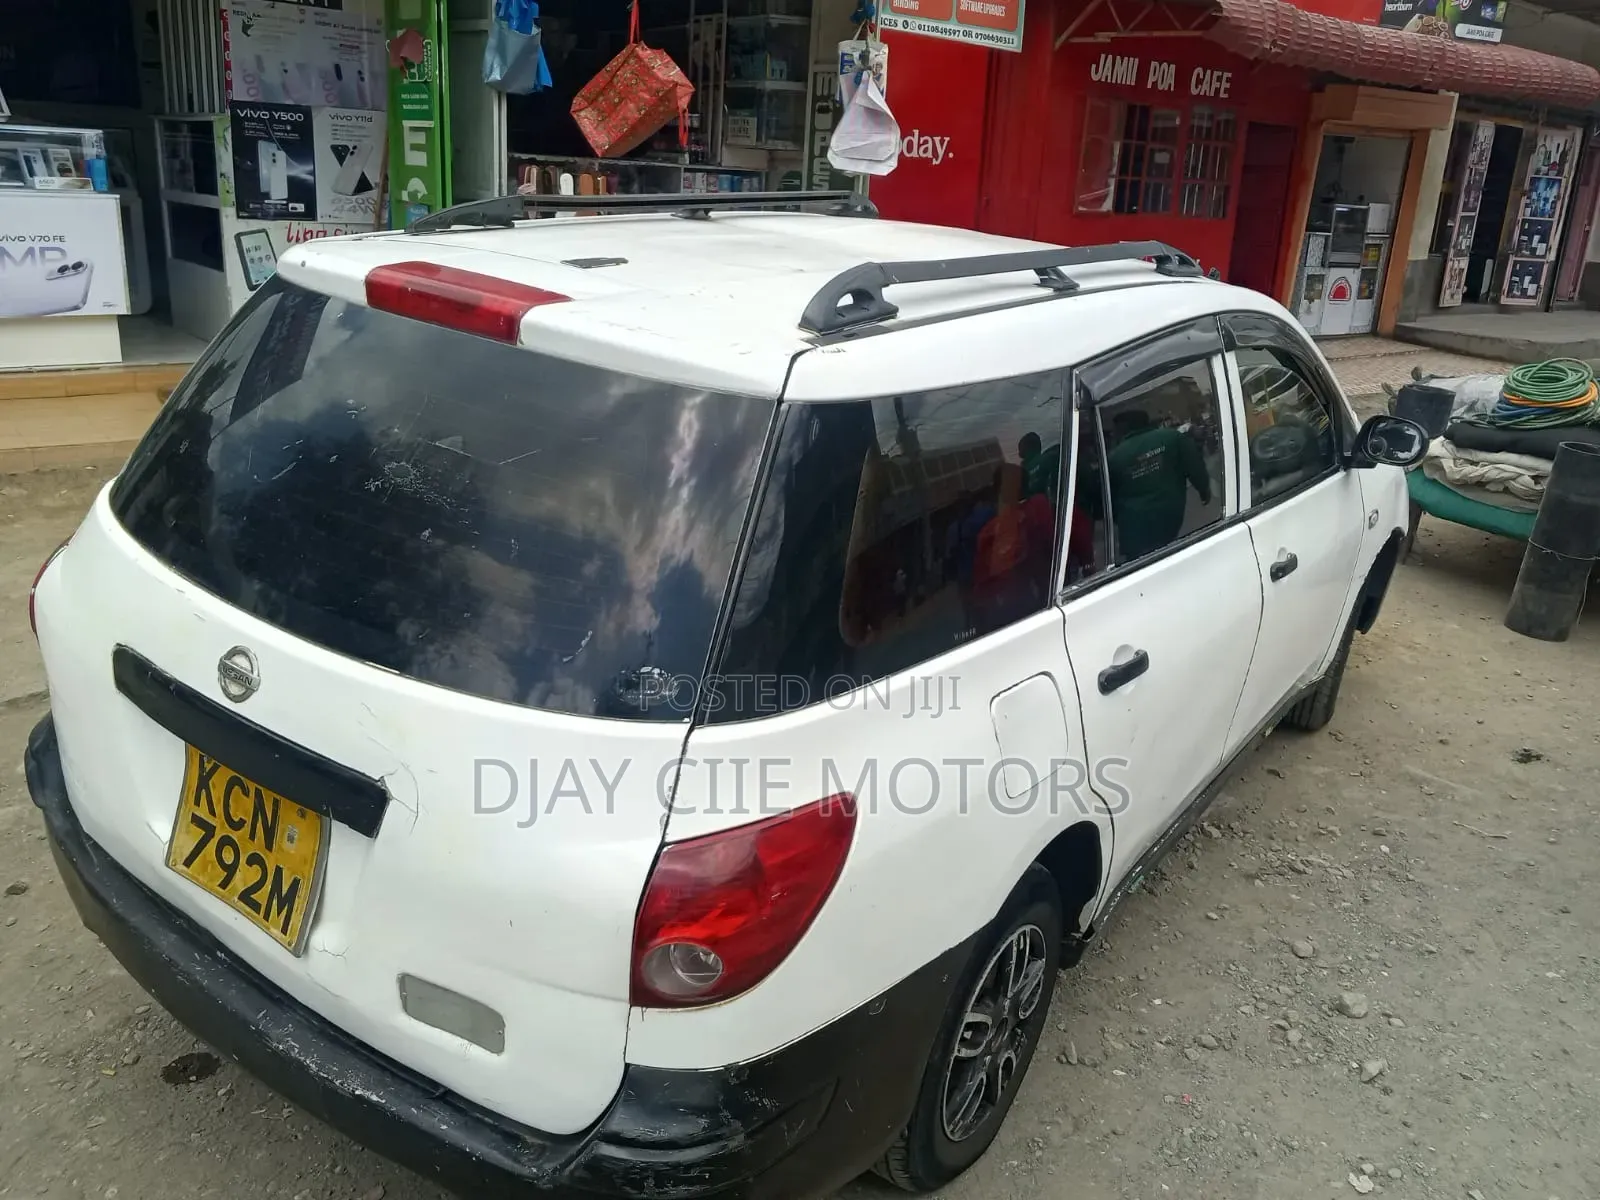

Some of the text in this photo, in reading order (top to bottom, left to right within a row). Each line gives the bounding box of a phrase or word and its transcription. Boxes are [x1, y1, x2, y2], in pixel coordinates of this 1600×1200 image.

[962, 29, 973, 39] OR
[1090, 53, 1232, 98] JAMII POA CAFE
[236, 108, 304, 122] vivo Y500
[329, 112, 353, 121] vivo
[899, 129, 954, 165] day.
[29, 235, 51, 243] V70
[53, 235, 66, 243] FE
[193, 754, 281, 853] KCN
[182, 813, 302, 935] 792M
